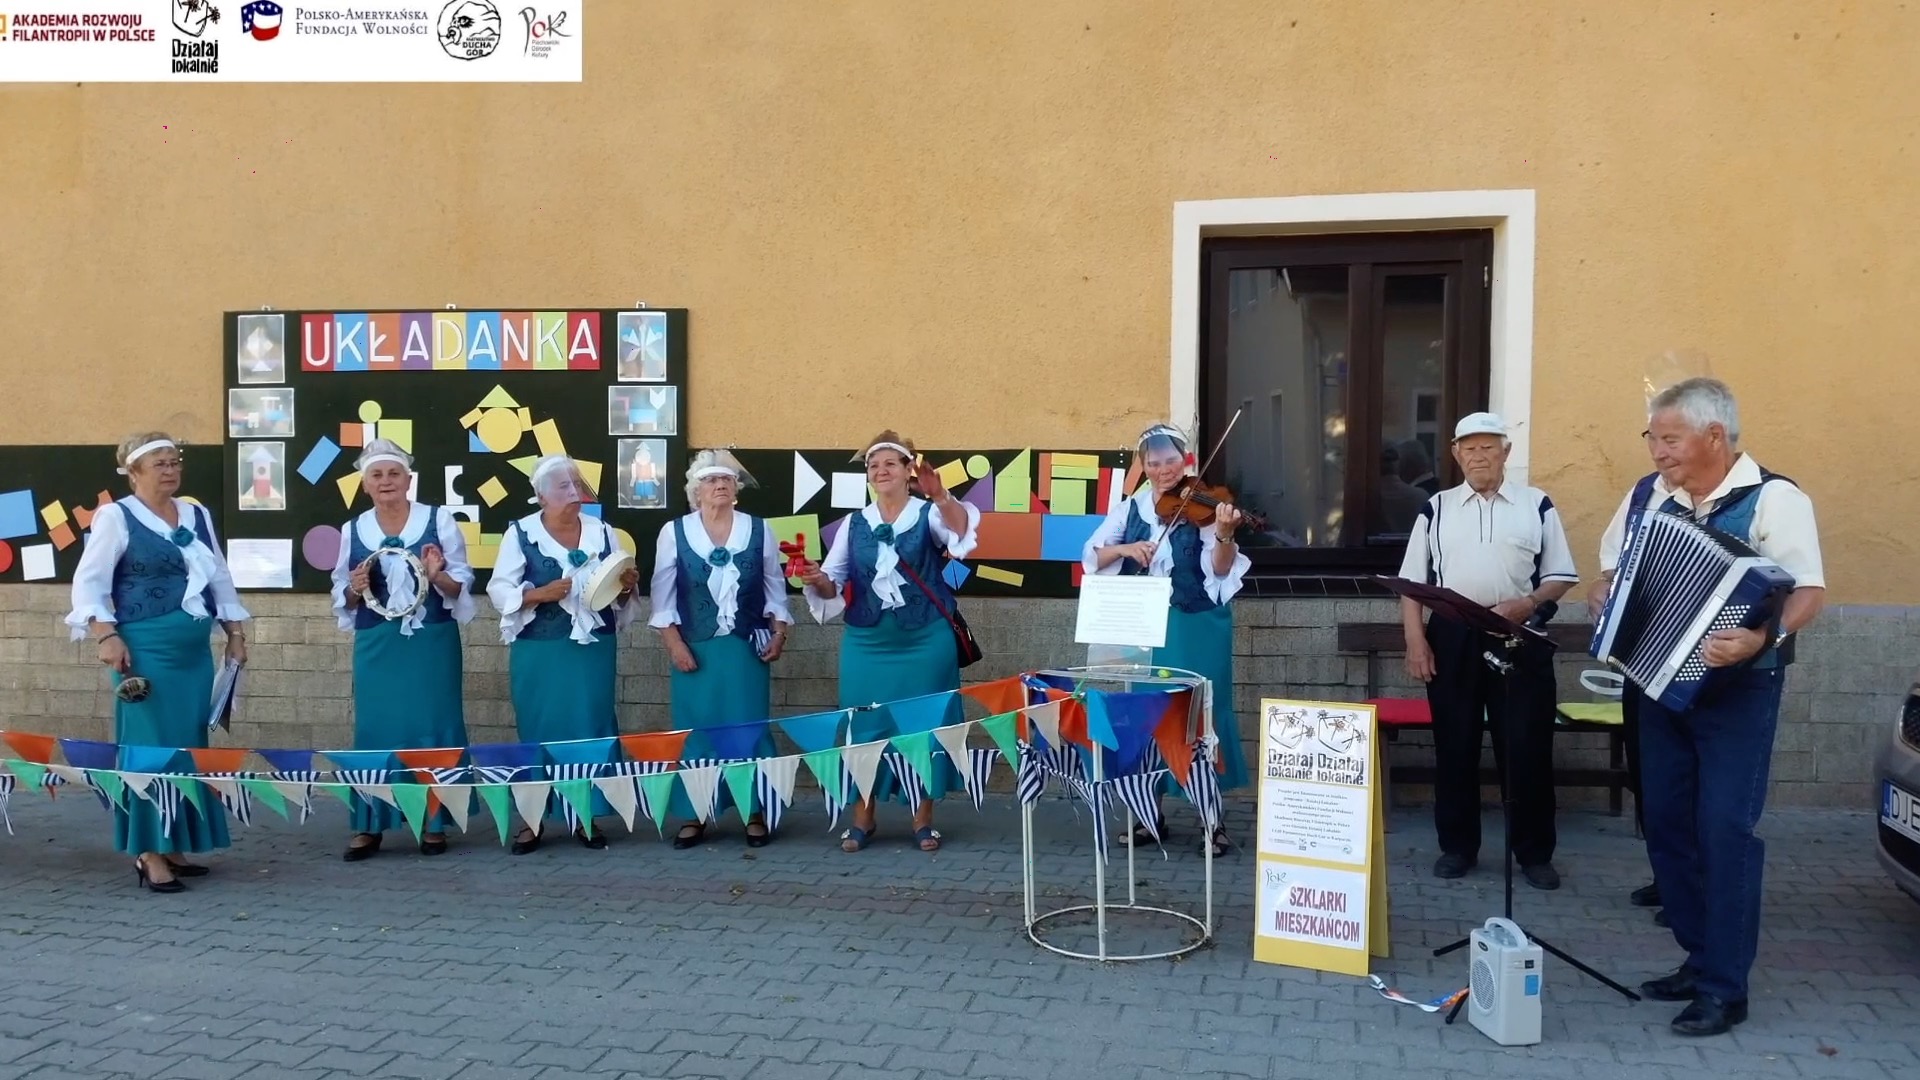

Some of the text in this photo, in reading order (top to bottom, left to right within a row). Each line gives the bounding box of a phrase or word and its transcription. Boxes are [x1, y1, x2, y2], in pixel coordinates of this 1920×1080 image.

[304, 318, 598, 366] UKŁADANKA
[1268, 748, 1314, 768] Działaj
[1317, 753, 1365, 774] Działaj
[1267, 765, 1313, 780] lokalnie
[1317, 770, 1364, 786] lokalnie
[1289, 886, 1347, 914] SZKLARKI
[1275, 911, 1360, 943] MIESZKAŃCOM
